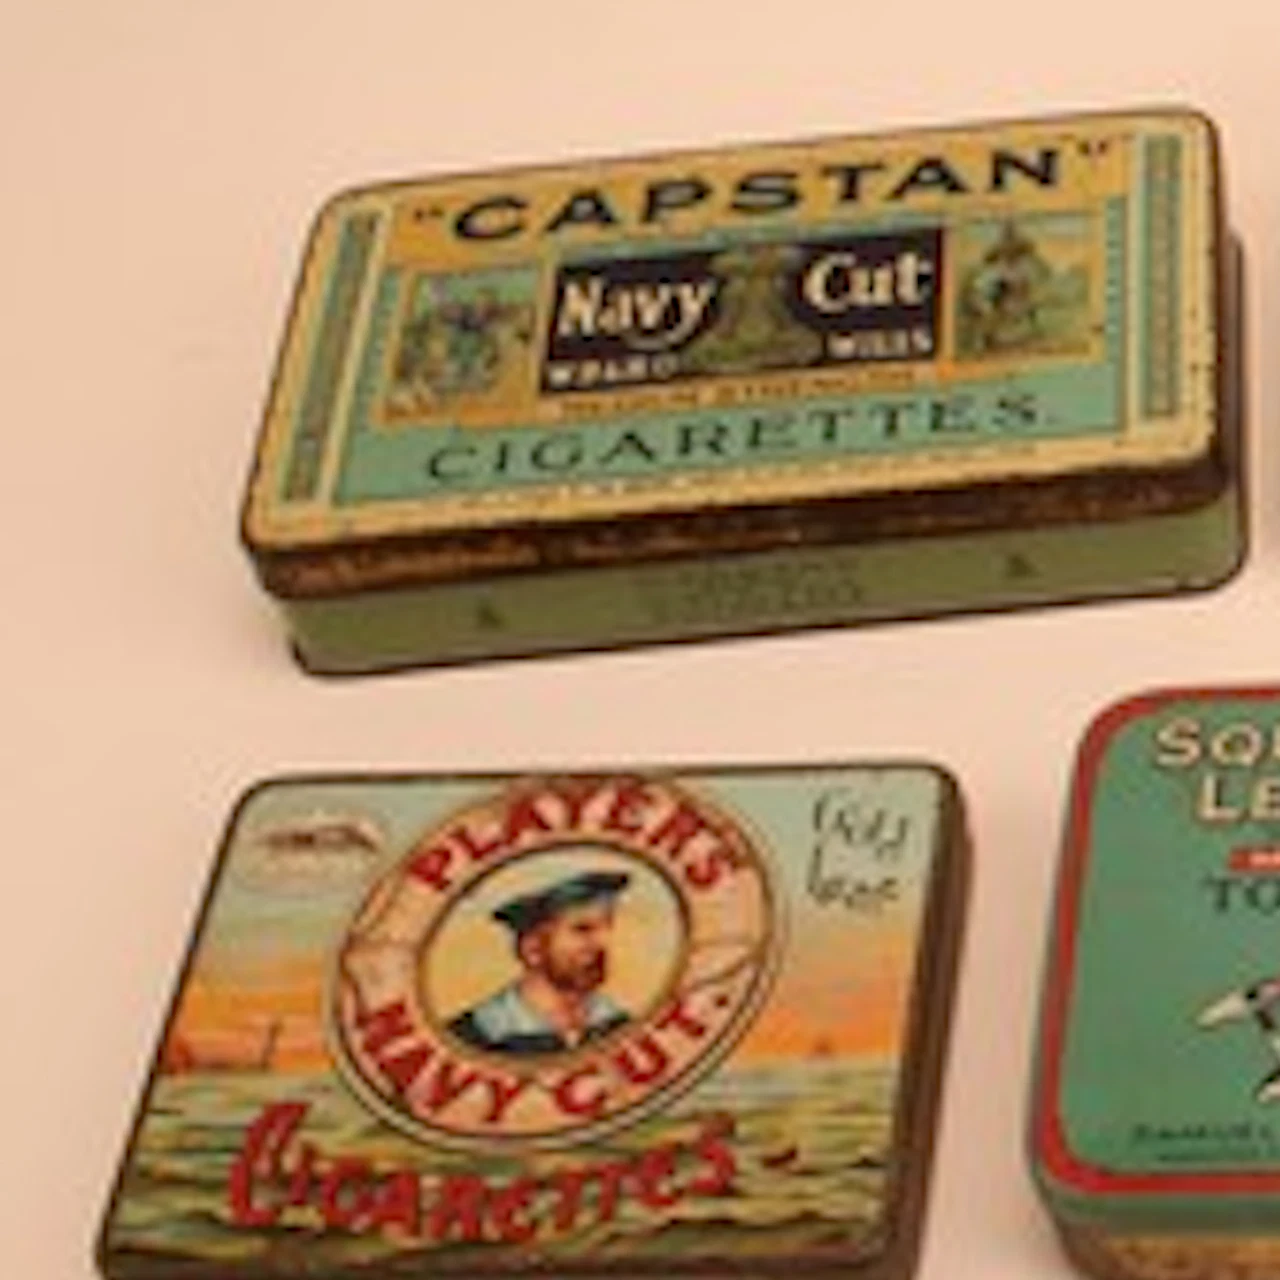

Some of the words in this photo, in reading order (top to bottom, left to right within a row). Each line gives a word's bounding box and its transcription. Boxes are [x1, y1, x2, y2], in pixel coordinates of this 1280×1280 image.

[555, 273, 718, 352] Navy
[803, 251, 933, 316] Cut
[427, 391, 1042, 486] CIGARETTES
[355, 999, 530, 1124] NAVY
